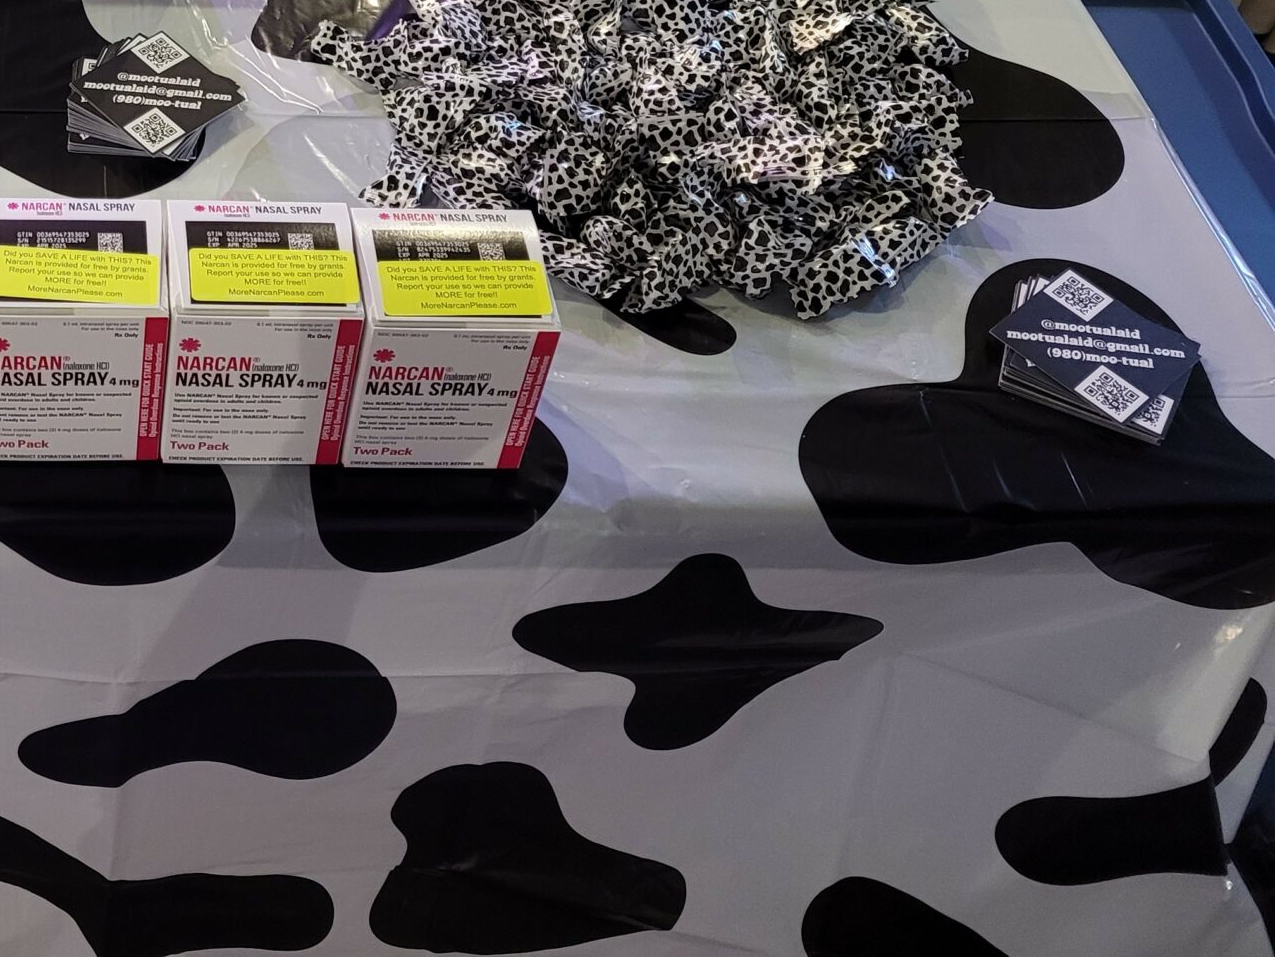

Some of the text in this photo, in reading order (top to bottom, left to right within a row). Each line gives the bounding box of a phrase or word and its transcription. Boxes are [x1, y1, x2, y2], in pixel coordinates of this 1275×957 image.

[117, 72, 200, 87] @mootualaid
[84, 80, 232, 102] mootualaid@gmail.com
[112, 94, 201, 111] (980)moo-tual
[69, 202, 101, 211] NASAL
[104, 202, 135, 212] SPRAY
[1041, 319, 1141, 340] @mootualaid
[1007, 330, 1185, 358] mootualaid@gmail.com
[1047, 347, 1154, 368] (980)moo-tual
[51, 371, 108, 385] SPRAY
[175, 372, 296, 387] NASAL SPRAY
[365, 381, 488, 395] NASAL SPRAY
[17, 439, 49, 448] Pack
[170, 440, 229, 450] Two Pack
[353, 445, 412, 455] Two Pack
